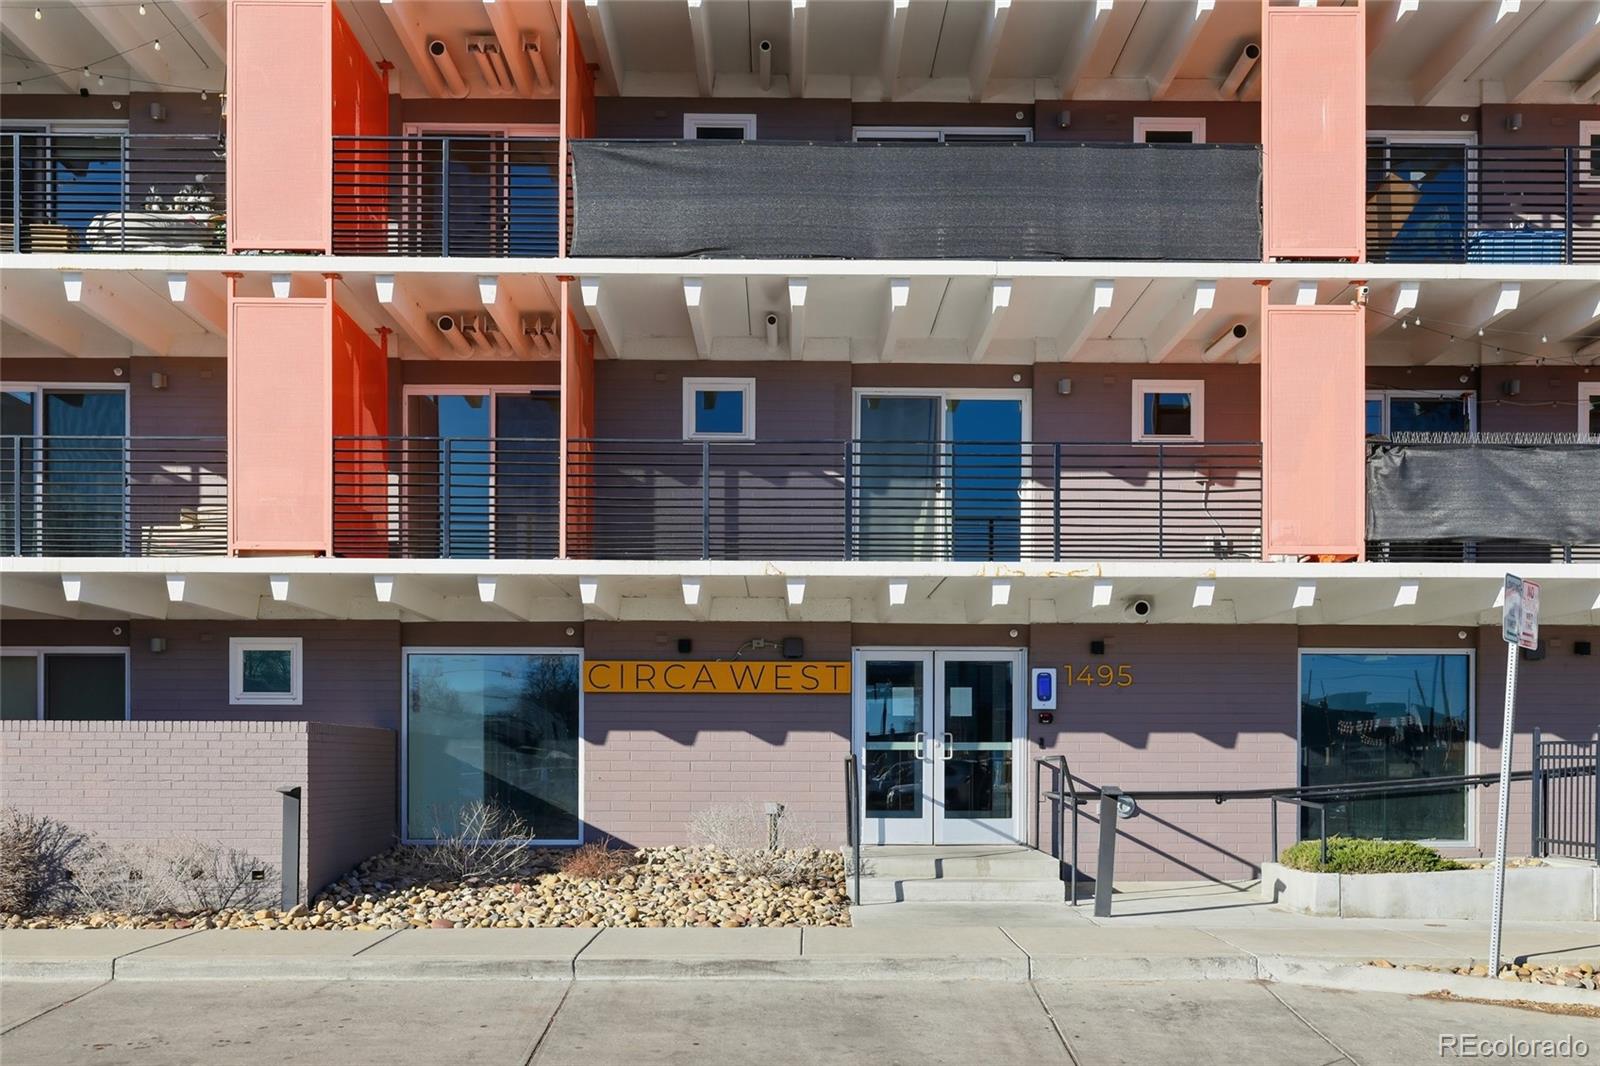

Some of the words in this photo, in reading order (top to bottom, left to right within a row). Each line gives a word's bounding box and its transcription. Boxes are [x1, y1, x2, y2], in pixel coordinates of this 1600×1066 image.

[588, 663, 717, 690] CIRCA
[729, 664, 845, 691] WEST
[1063, 664, 1135, 687] 1495
